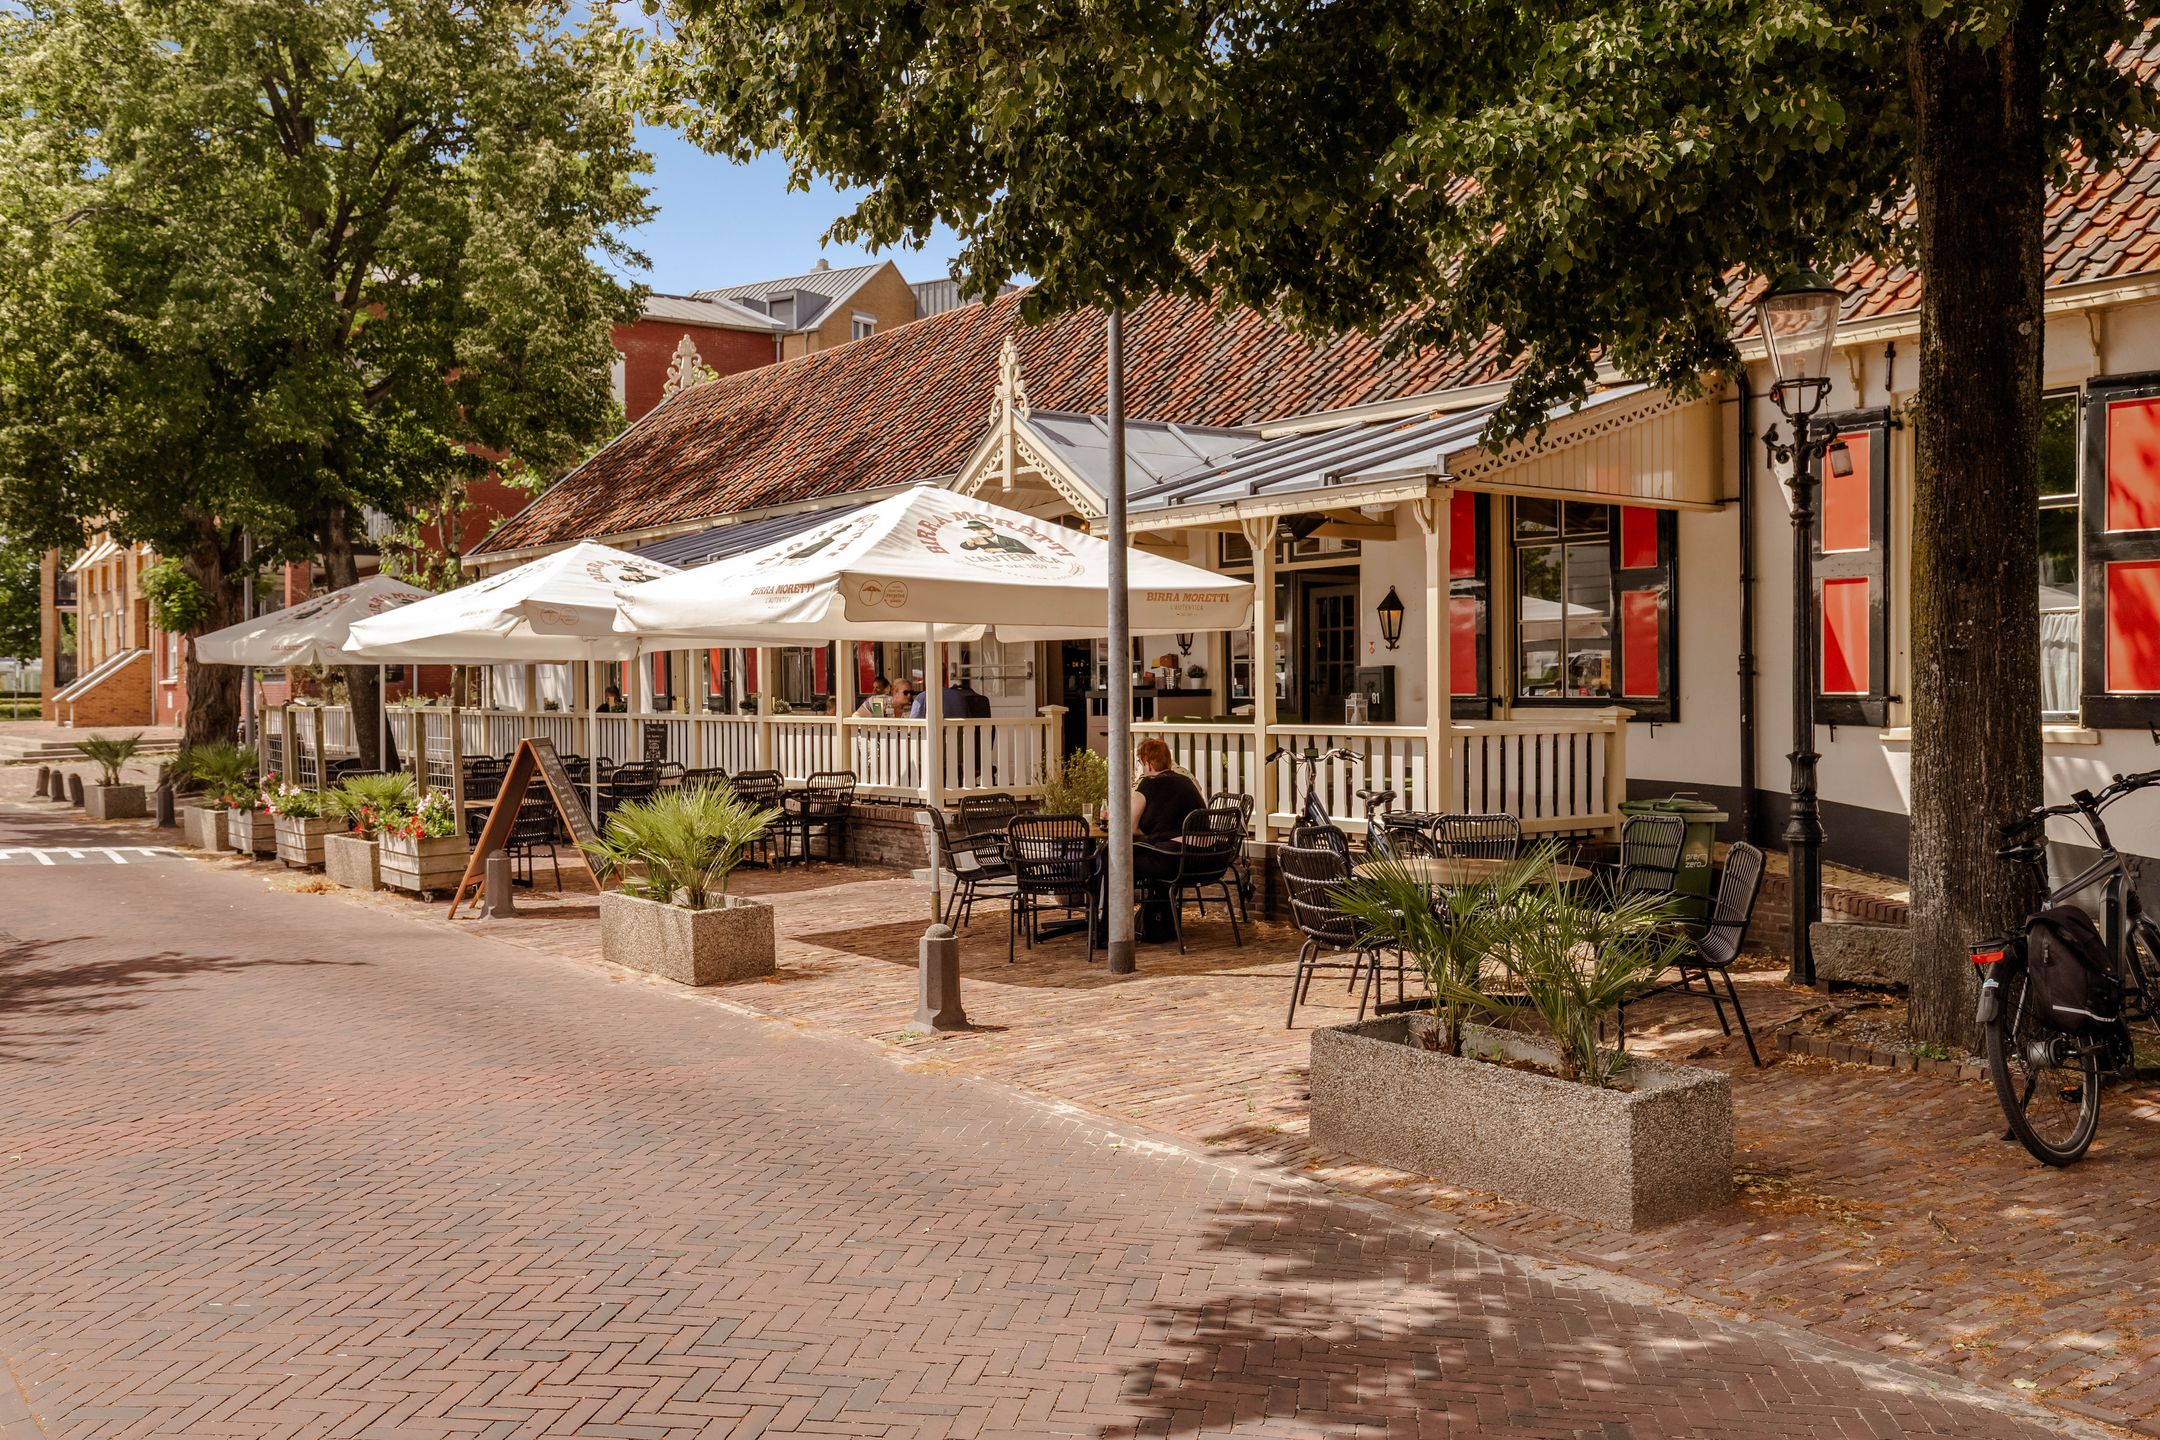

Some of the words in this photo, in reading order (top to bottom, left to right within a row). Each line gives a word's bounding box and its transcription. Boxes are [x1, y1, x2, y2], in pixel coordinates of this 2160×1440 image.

[916, 514, 953, 555] BIRRA
[949, 511, 1076, 557] MORETTI
[775, 582, 816, 595] MORETTI
[1146, 592, 1180, 602] BIRRA
[1182, 593, 1230, 602] MORETTI
[1371, 692, 1380, 704] 81
